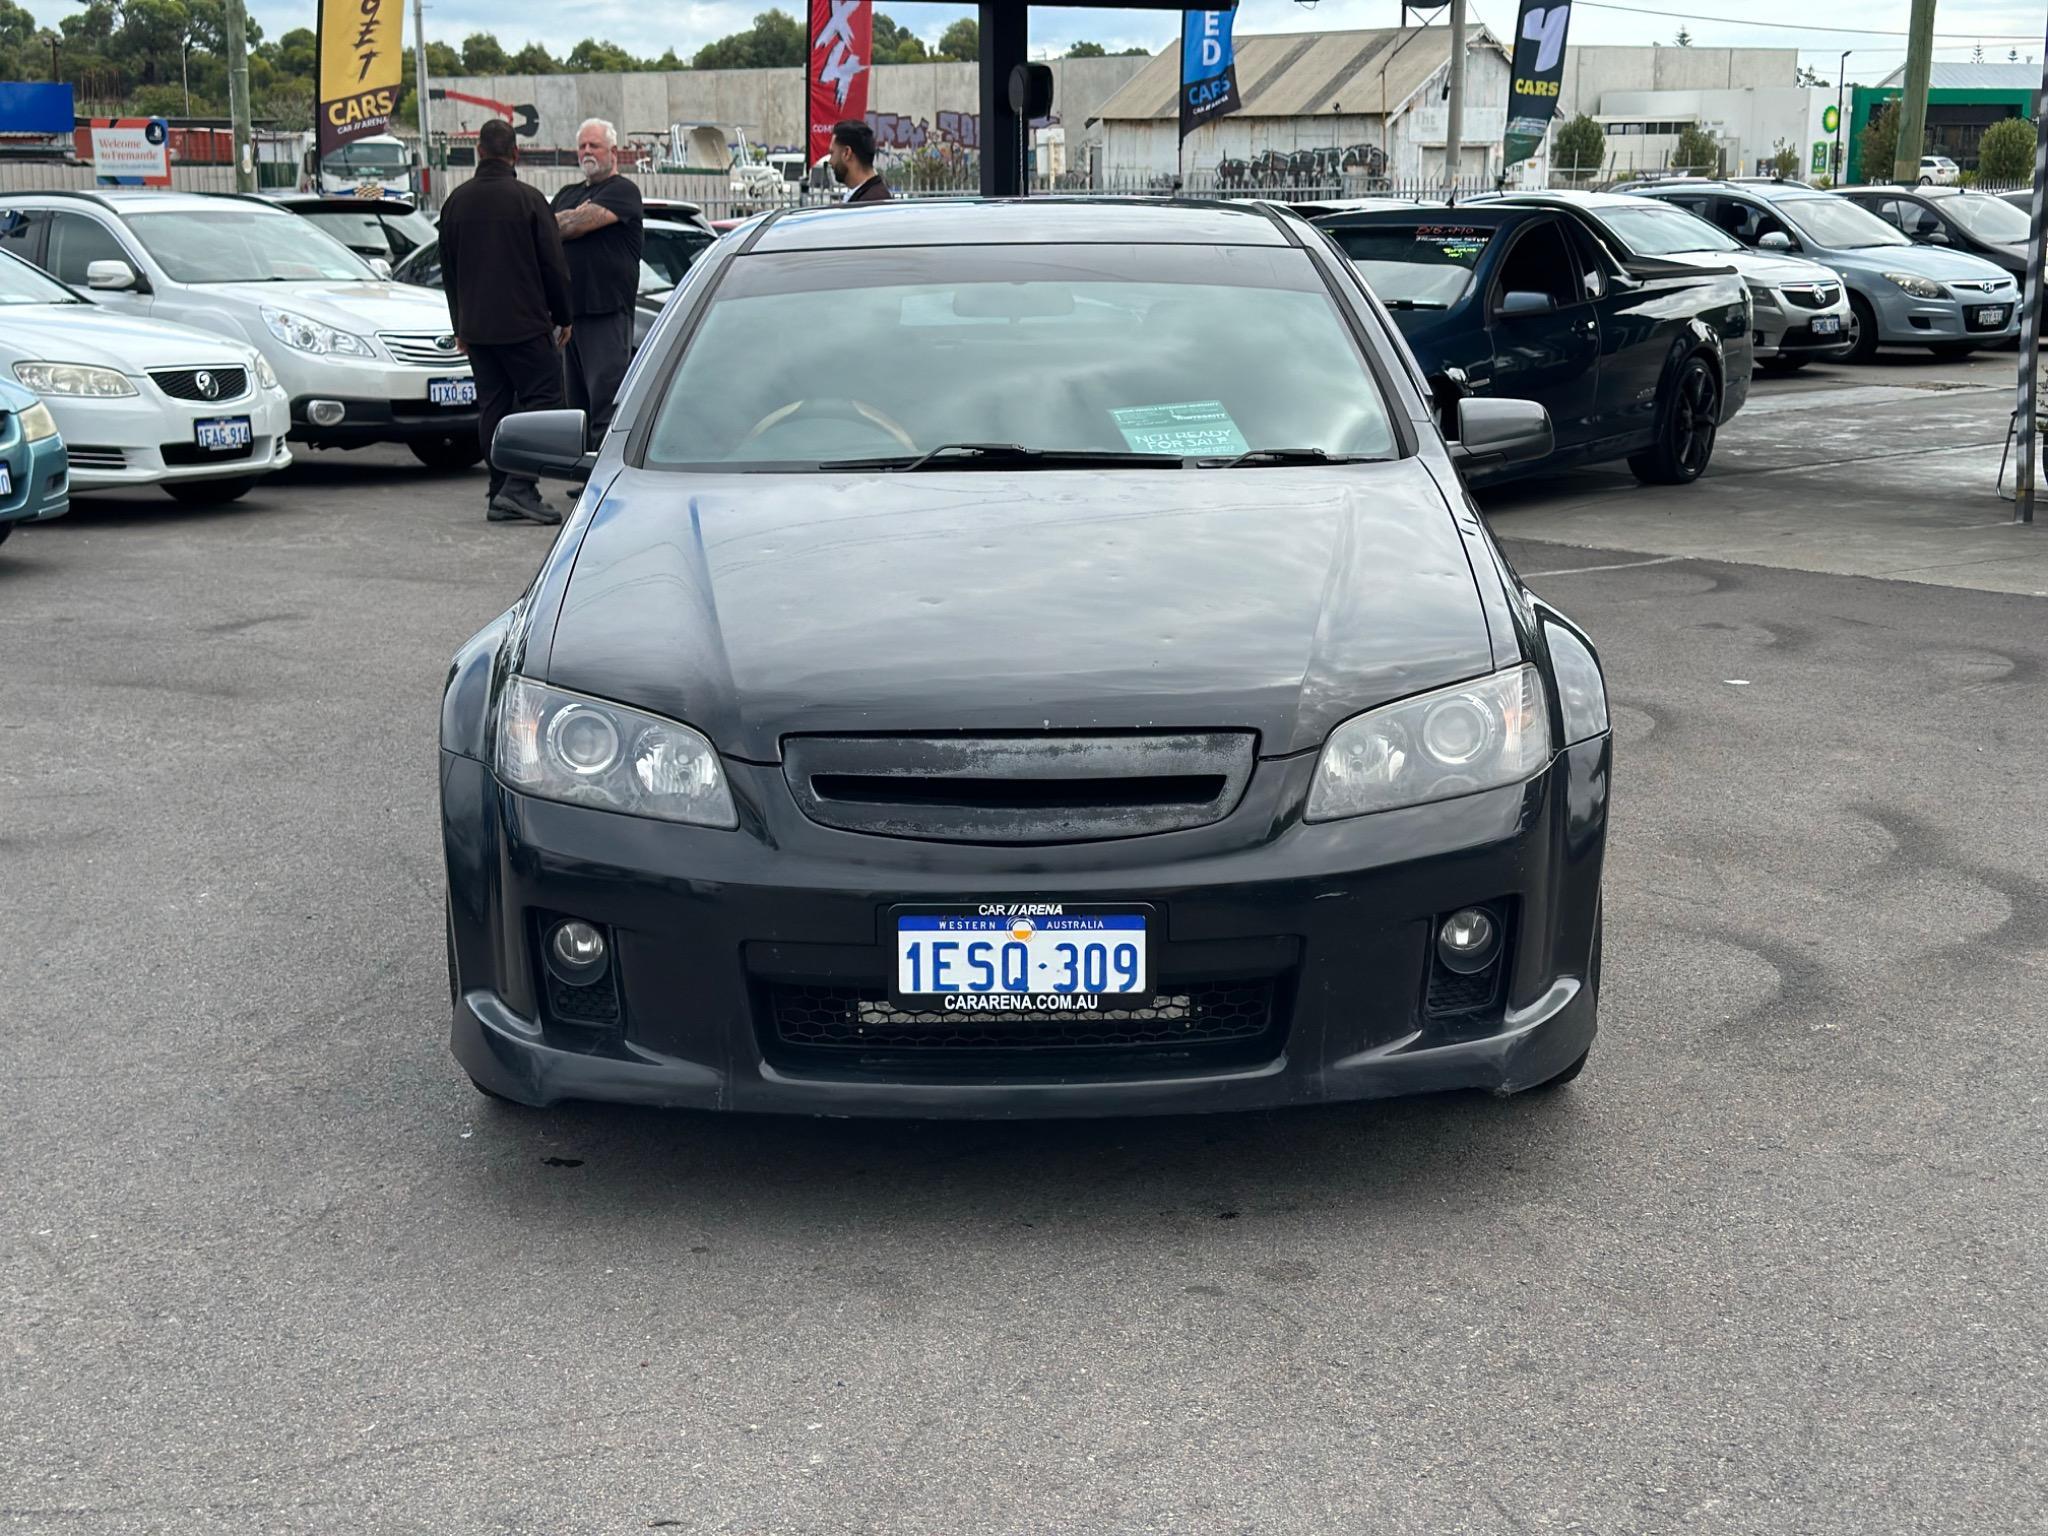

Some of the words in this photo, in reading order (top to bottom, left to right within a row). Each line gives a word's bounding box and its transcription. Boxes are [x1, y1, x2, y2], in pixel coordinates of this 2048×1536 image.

[1188, 76, 1232, 105] CARS
[1515, 79, 1559, 97] CARS
[329, 91, 393, 126] CARS
[337, 124, 353, 135] CAR
[99, 138, 142, 149] Welcome
[101, 150, 111, 160] to
[112, 150, 158, 161] Fremantle
[1135, 434, 1170, 444] NOT
[1175, 429, 1232, 440] READY
[1147, 439, 1185, 450] FOR
[1187, 436, 1228, 447] SALE
[979, 904, 1005, 916] CAR
[938, 920, 996, 930] WESTERN
[1046, 920, 1104, 930] AUSTRALIA
[944, 994, 1098, 1011] CARARENA.COM.AU
